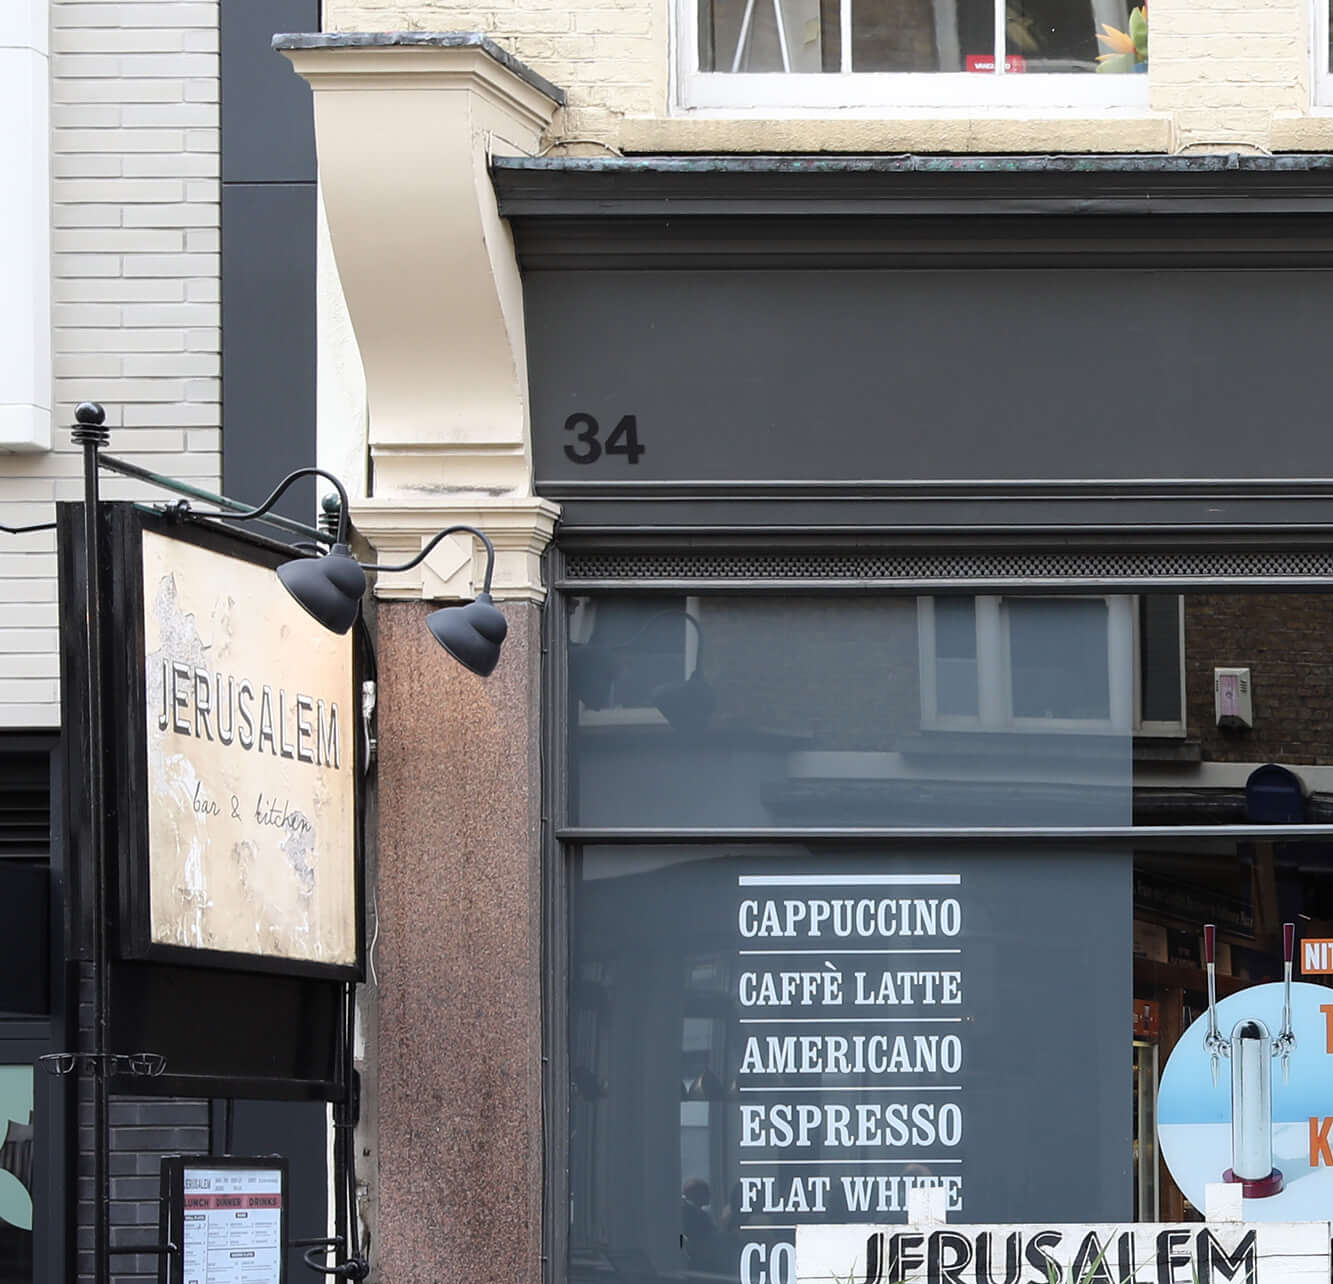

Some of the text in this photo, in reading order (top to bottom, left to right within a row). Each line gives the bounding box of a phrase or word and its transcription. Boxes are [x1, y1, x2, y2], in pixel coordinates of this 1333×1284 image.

[563, 413, 645, 465] 34
[158, 657, 341, 771] JERUSALEM
[192, 781, 311, 833] bar & kitchen
[739, 899, 961, 938] CAPPUCCINO
[739, 961, 961, 1006] CAFFÈ LATTE
[740, 1035, 962, 1073] AMERICANO
[740, 1102, 962, 1148] ESPRESSO
[249, 1197, 277, 1206] DRINKS
[740, 1177, 830, 1212] FLAT
